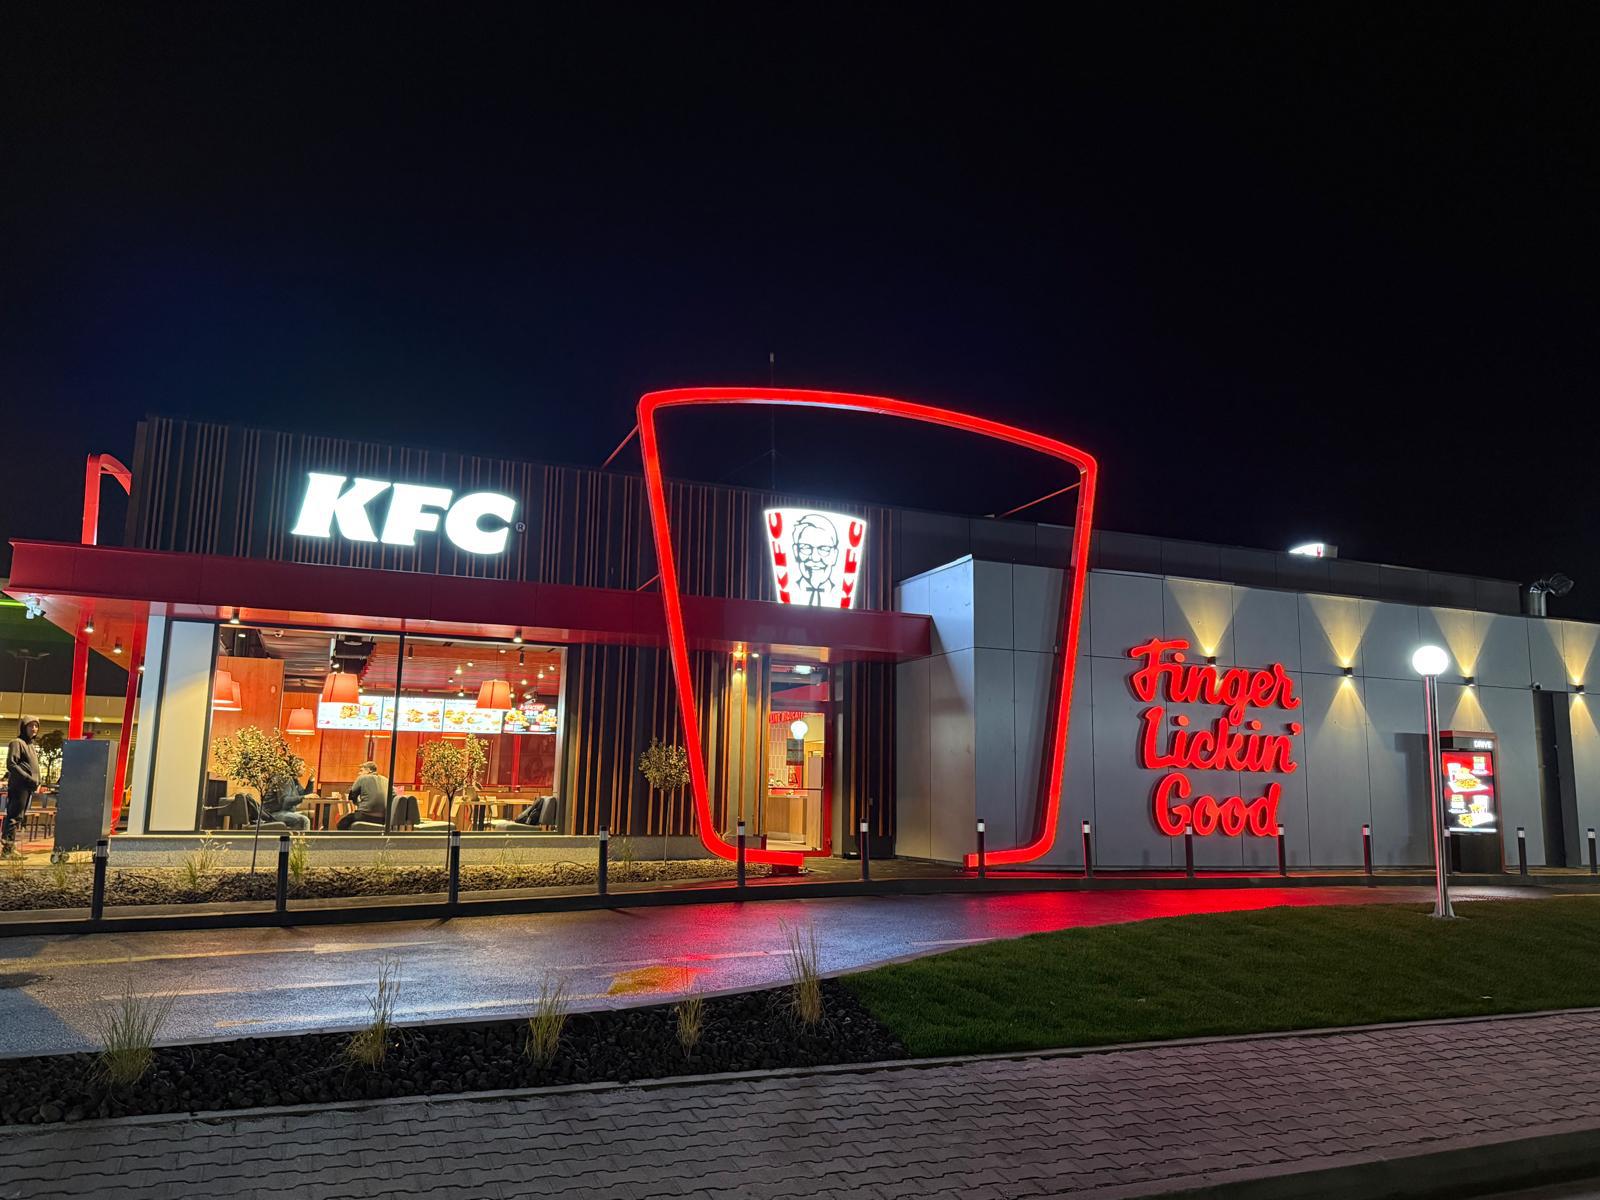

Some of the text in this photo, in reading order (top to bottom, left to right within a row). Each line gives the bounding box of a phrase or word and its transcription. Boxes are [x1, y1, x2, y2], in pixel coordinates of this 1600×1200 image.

[291, 472, 516, 554] KFC
[1129, 638, 1301, 726] Finger
[1143, 705, 1302, 773] Lickin'
[1154, 772, 1281, 837] Good
